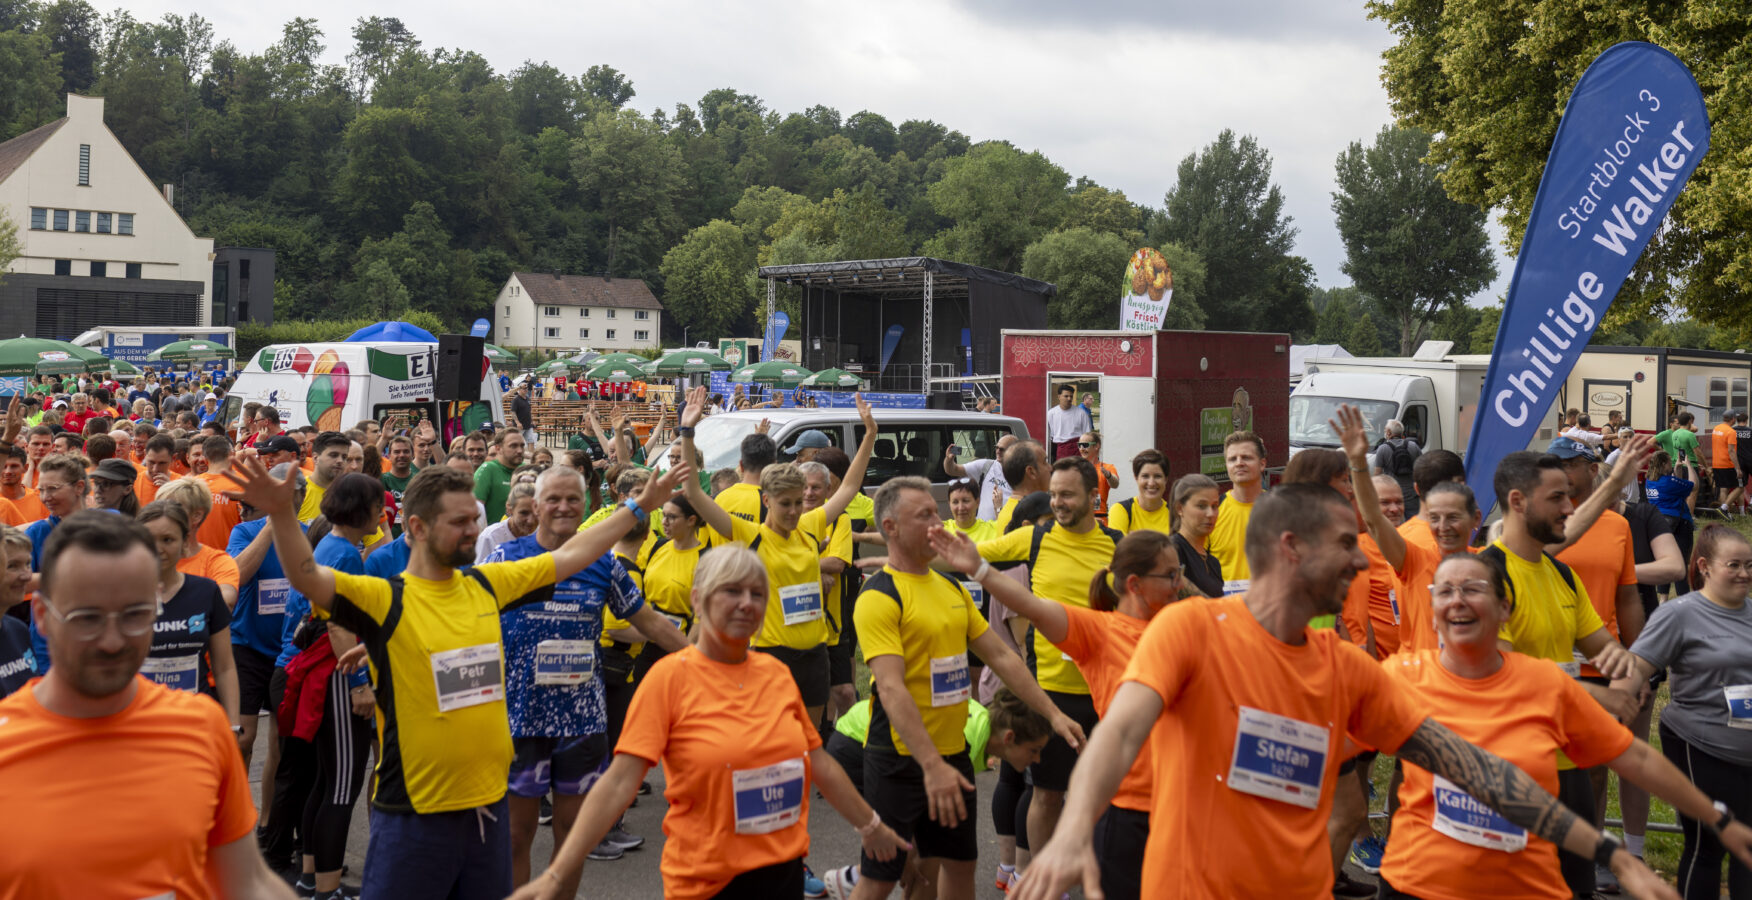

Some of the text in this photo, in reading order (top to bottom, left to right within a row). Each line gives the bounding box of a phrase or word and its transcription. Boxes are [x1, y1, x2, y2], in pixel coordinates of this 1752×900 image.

[1557, 88, 1661, 240] Startblock 3
[1494, 120, 1695, 428] Chillige Walker
[1134, 310, 1159, 324] Frisch
[272, 348, 297, 371] EIS
[388, 384, 400, 393] Sie
[401, 381, 427, 391] können
[390, 392, 403, 400] Info
[404, 389, 424, 398] Telefon
[539, 654, 563, 665] Karl
[154, 673, 181, 683] Nina
[458, 664, 487, 680] Petr
[1255, 738, 1310, 769] Stefan
[762, 785, 785, 802] Ute
